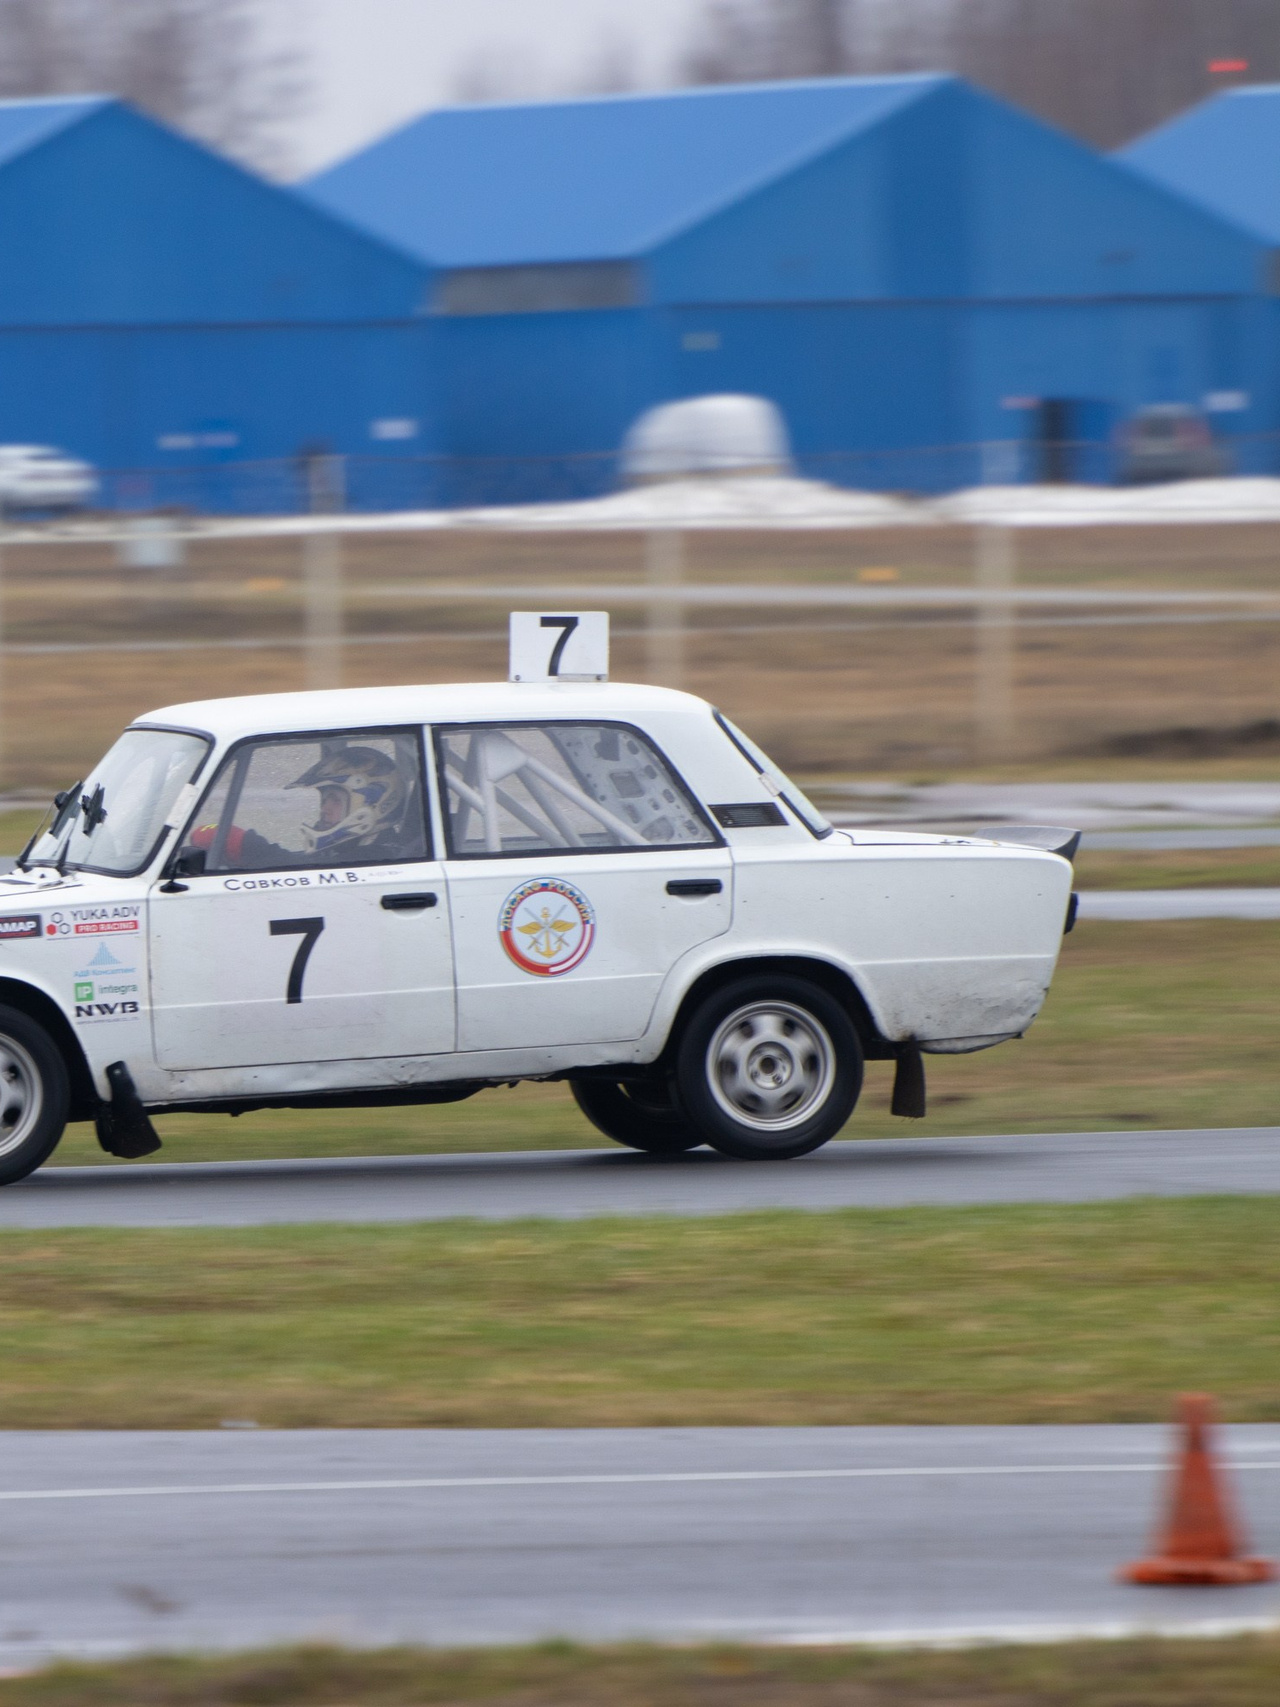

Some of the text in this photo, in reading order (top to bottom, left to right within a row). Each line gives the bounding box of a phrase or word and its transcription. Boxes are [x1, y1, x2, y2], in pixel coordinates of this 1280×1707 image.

[540, 616, 579, 676] 7
[224, 877, 310, 891] Савков
[319, 872, 366, 884] М.В.
[70, 906, 140, 921] YUKA ADV
[77, 921, 135, 933] PRO RACING
[269, 916, 325, 1004] 7
[77, 984, 138, 998] IP integra
[75, 1001, 139, 1017] NWB
